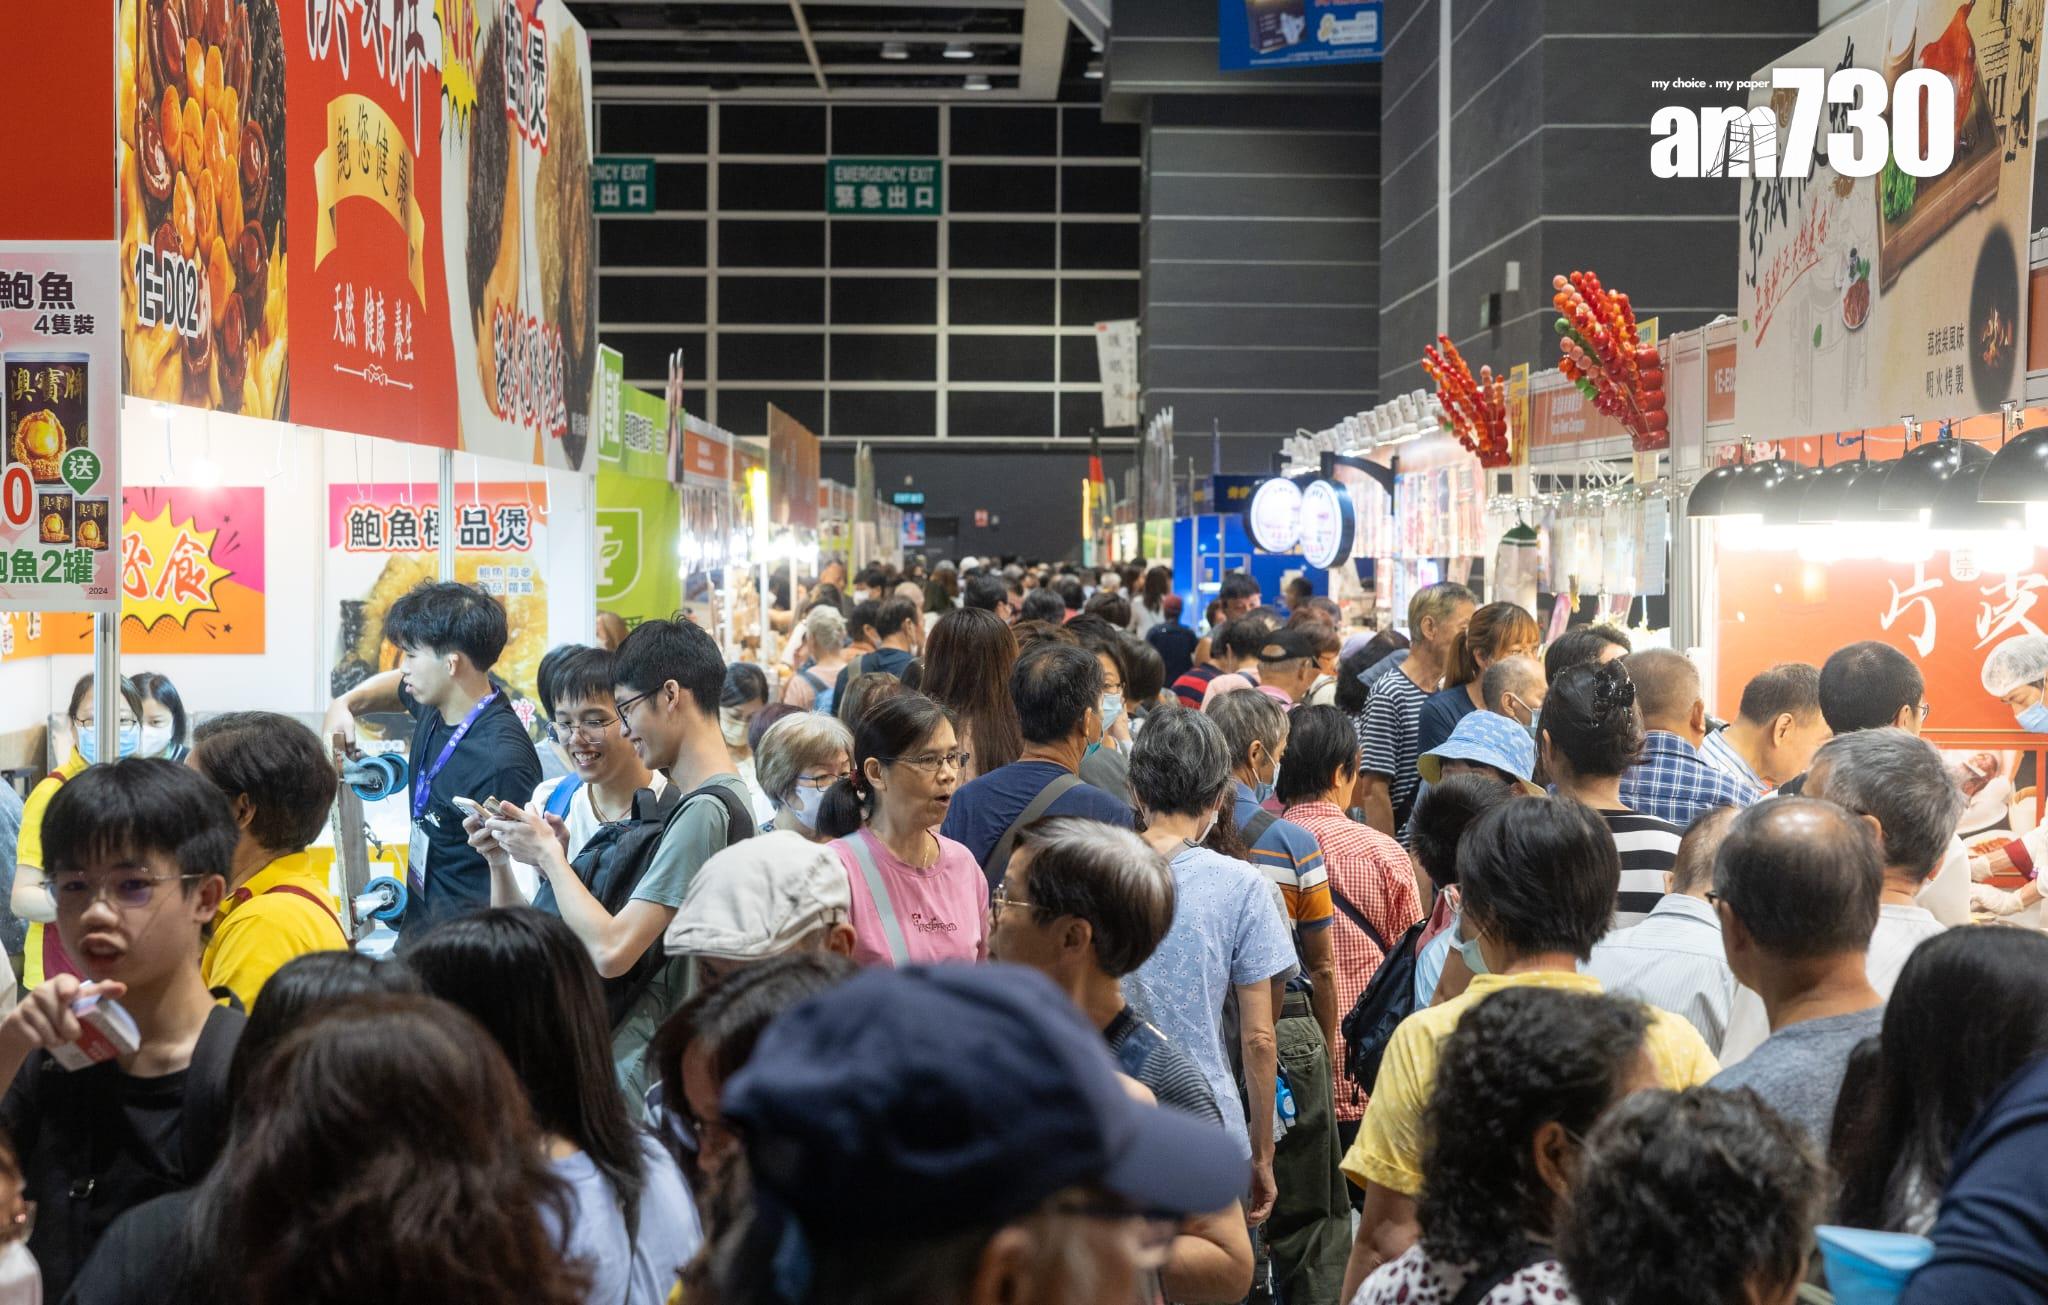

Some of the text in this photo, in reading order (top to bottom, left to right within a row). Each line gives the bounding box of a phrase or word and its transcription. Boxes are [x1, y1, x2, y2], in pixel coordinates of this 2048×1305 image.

[621, 164, 648, 181] EXIT
[834, 166, 935, 182] EMERGENCY EXIT
[834, 185, 934, 208] 緊急出口
[0, 272, 76, 309] 鮑魚
[135, 247, 197, 332] 1E-D02
[34, 314, 94, 335] 4隻裝
[333, 282, 414, 362] 天然 健康 養生
[69, 455, 94, 480] 送
[88, 587, 108, 595] 2024
